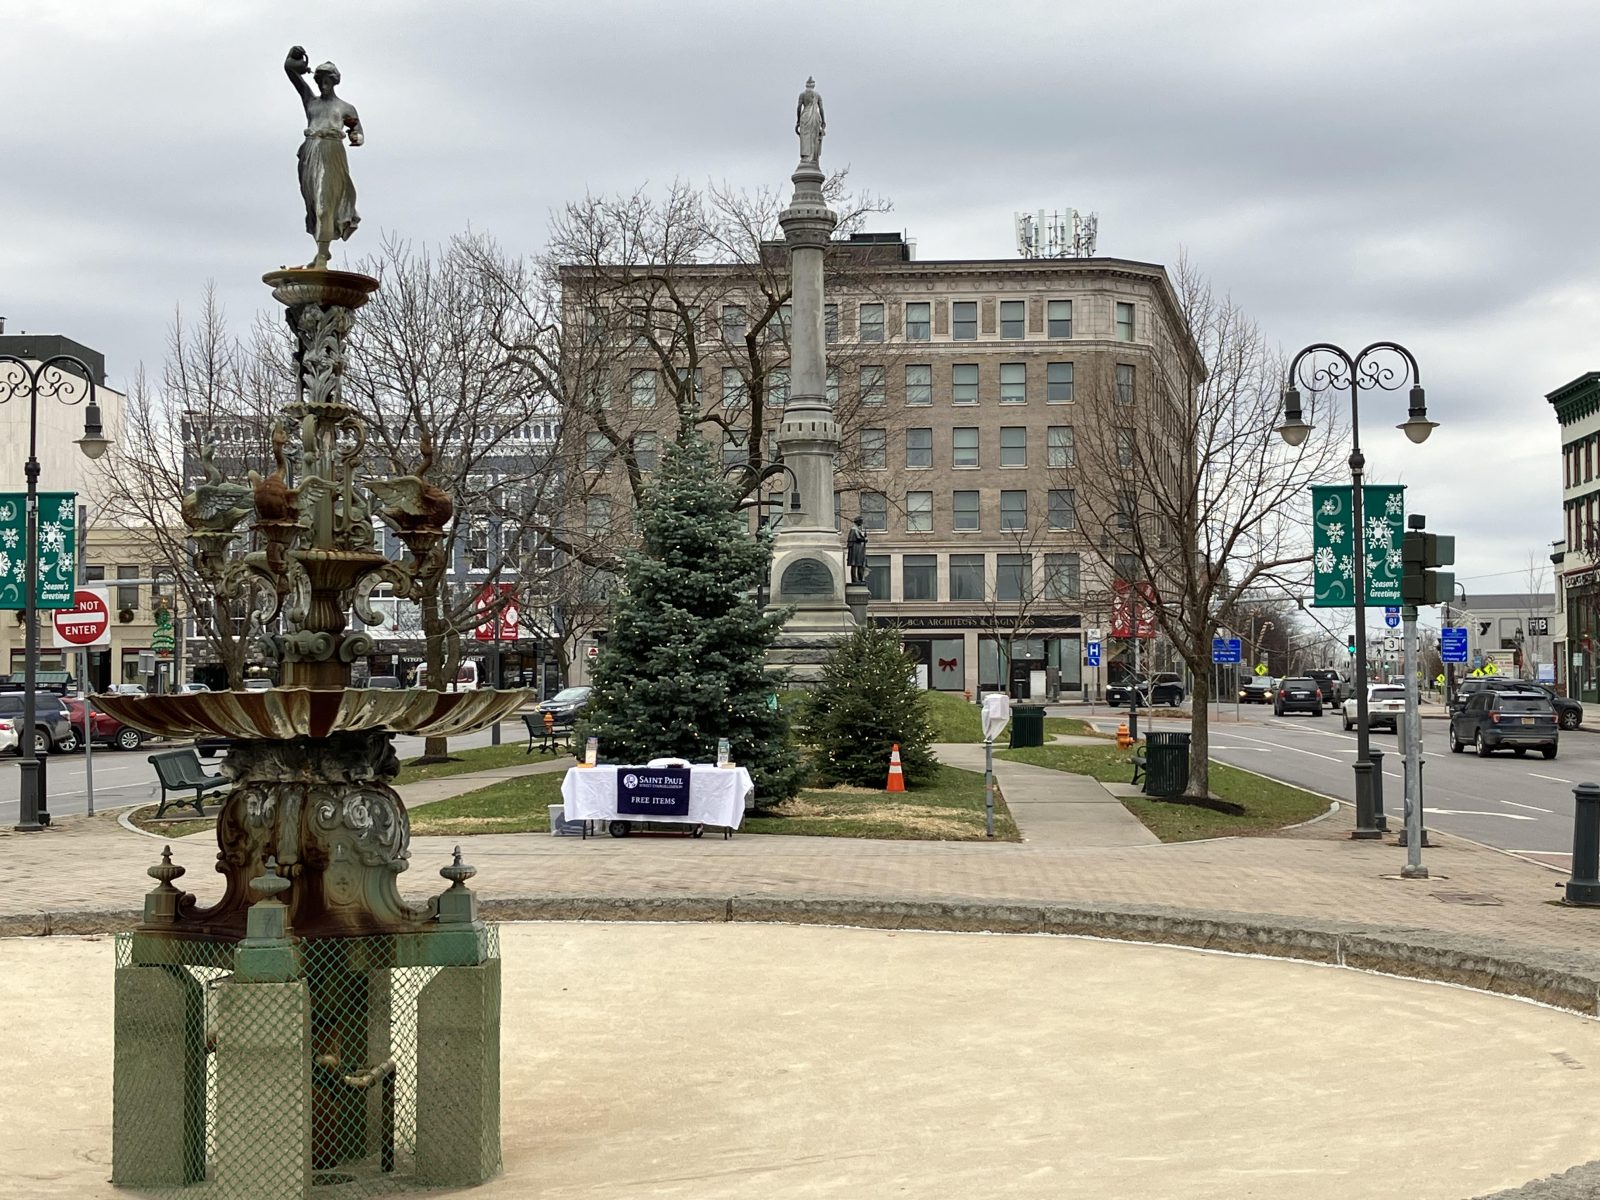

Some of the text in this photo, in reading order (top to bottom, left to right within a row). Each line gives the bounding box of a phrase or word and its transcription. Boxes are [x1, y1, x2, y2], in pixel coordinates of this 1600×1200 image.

[43, 581, 69, 590] Season's
[1371, 579, 1399, 588] Season's
[41, 591, 71, 602] Greetings
[1370, 589, 1401, 600] Greetings
[80, 601, 99, 611] NOT
[1388, 618, 1397, 626] 81
[65, 625, 97, 636] ENTER
[1389, 640, 1395, 648] 3
[1089, 644, 1099, 656] H
[639, 775, 684, 785] SAINT PAUL
[631, 796, 676, 805] FREE ITEMS
